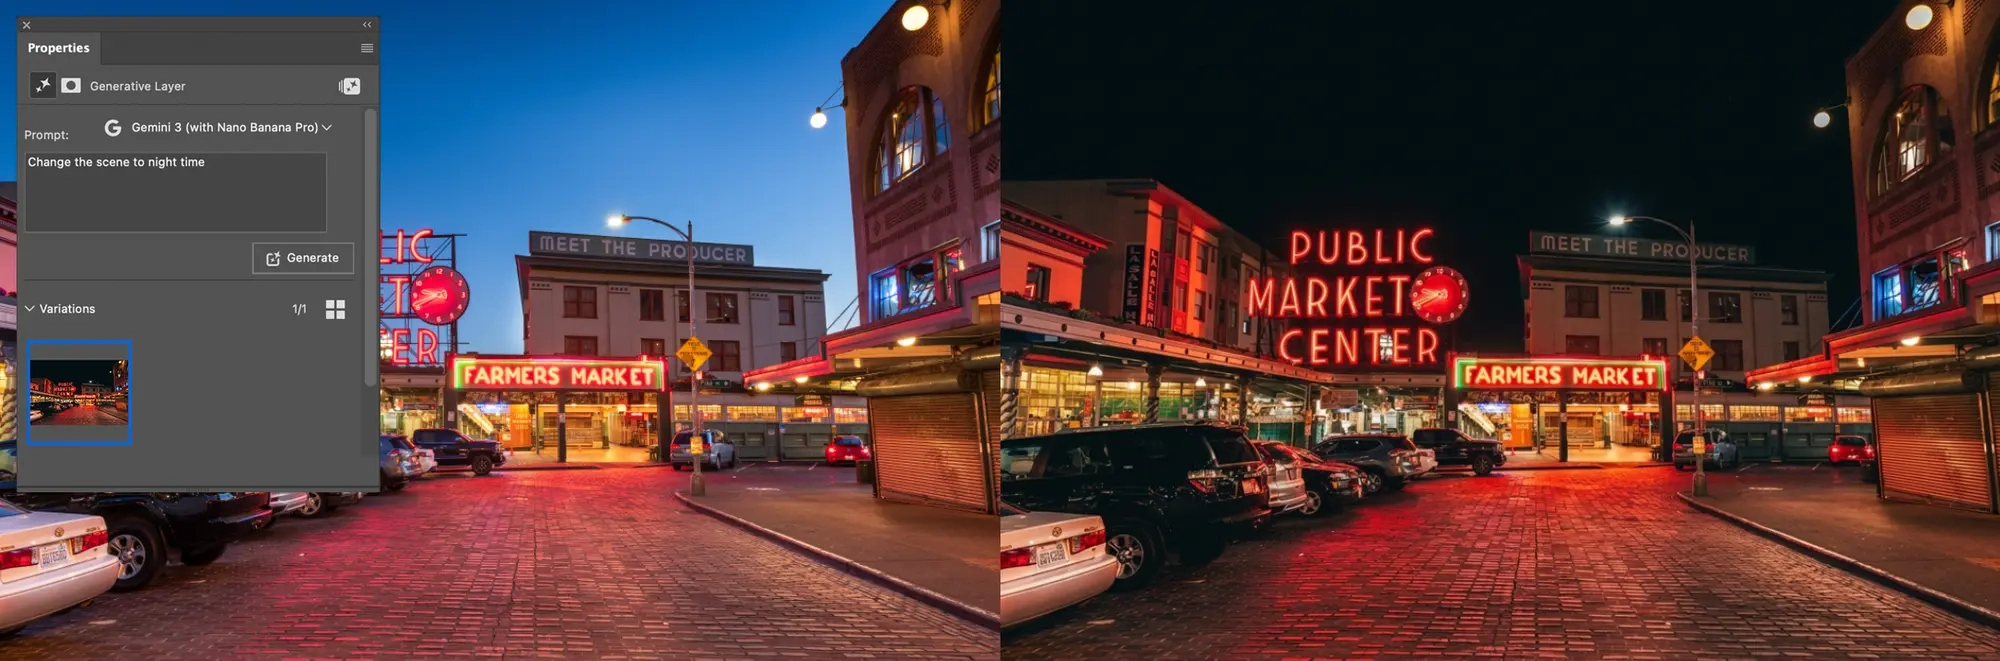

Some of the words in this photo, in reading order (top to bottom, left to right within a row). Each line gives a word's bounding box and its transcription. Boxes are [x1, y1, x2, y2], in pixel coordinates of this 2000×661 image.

[540, 235, 590, 253] MEET
[602, 239, 636, 256] THE
[649, 243, 747, 262] PRODUCER
[1290, 228, 1434, 265] PUBLIC
[1541, 235, 1592, 253] MEET
[1604, 239, 1638, 256] THE
[1651, 242, 1749, 261] PRODUCER
[1248, 275, 1411, 317] MARKET
[1279, 328, 1438, 365] CENTER
[464, 365, 560, 385] FARMERS
[571, 368, 654, 386] MARKET
[1465, 365, 1561, 385] FARMERS
[1573, 367, 1656, 386] MARKET
